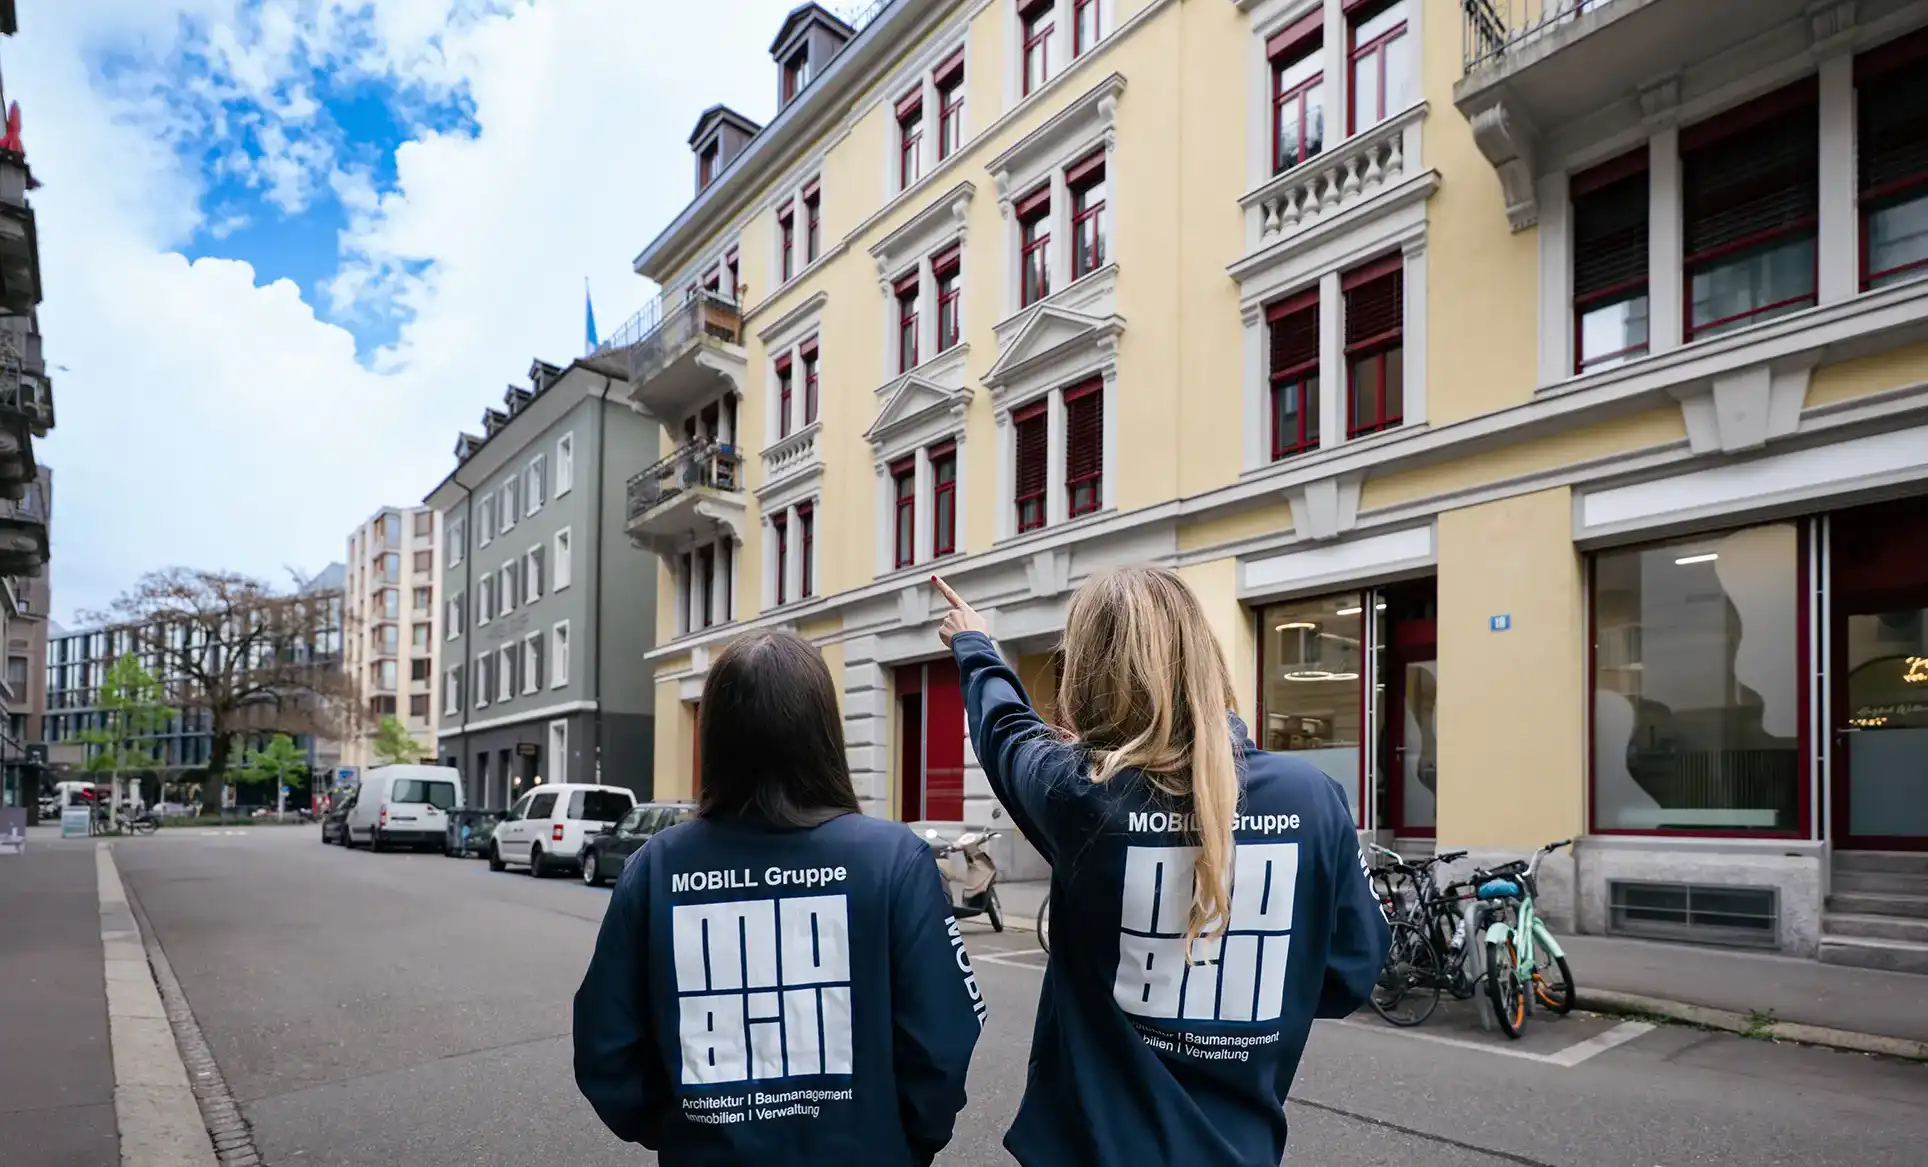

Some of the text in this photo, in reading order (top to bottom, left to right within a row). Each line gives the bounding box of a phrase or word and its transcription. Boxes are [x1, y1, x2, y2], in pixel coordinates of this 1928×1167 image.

[1128, 811, 1207, 834] MOBIL
[671, 866, 848, 893] MOBILL Gruppe
[1185, 1031, 1280, 1049] Baumanagement
[1185, 1046, 1250, 1062] Verwaltung
[682, 1095, 744, 1110] Architektur
[755, 1088, 853, 1105] Baumanagement
[685, 1111, 744, 1124] Immobilien
[756, 1103, 820, 1119] Verwaltung
